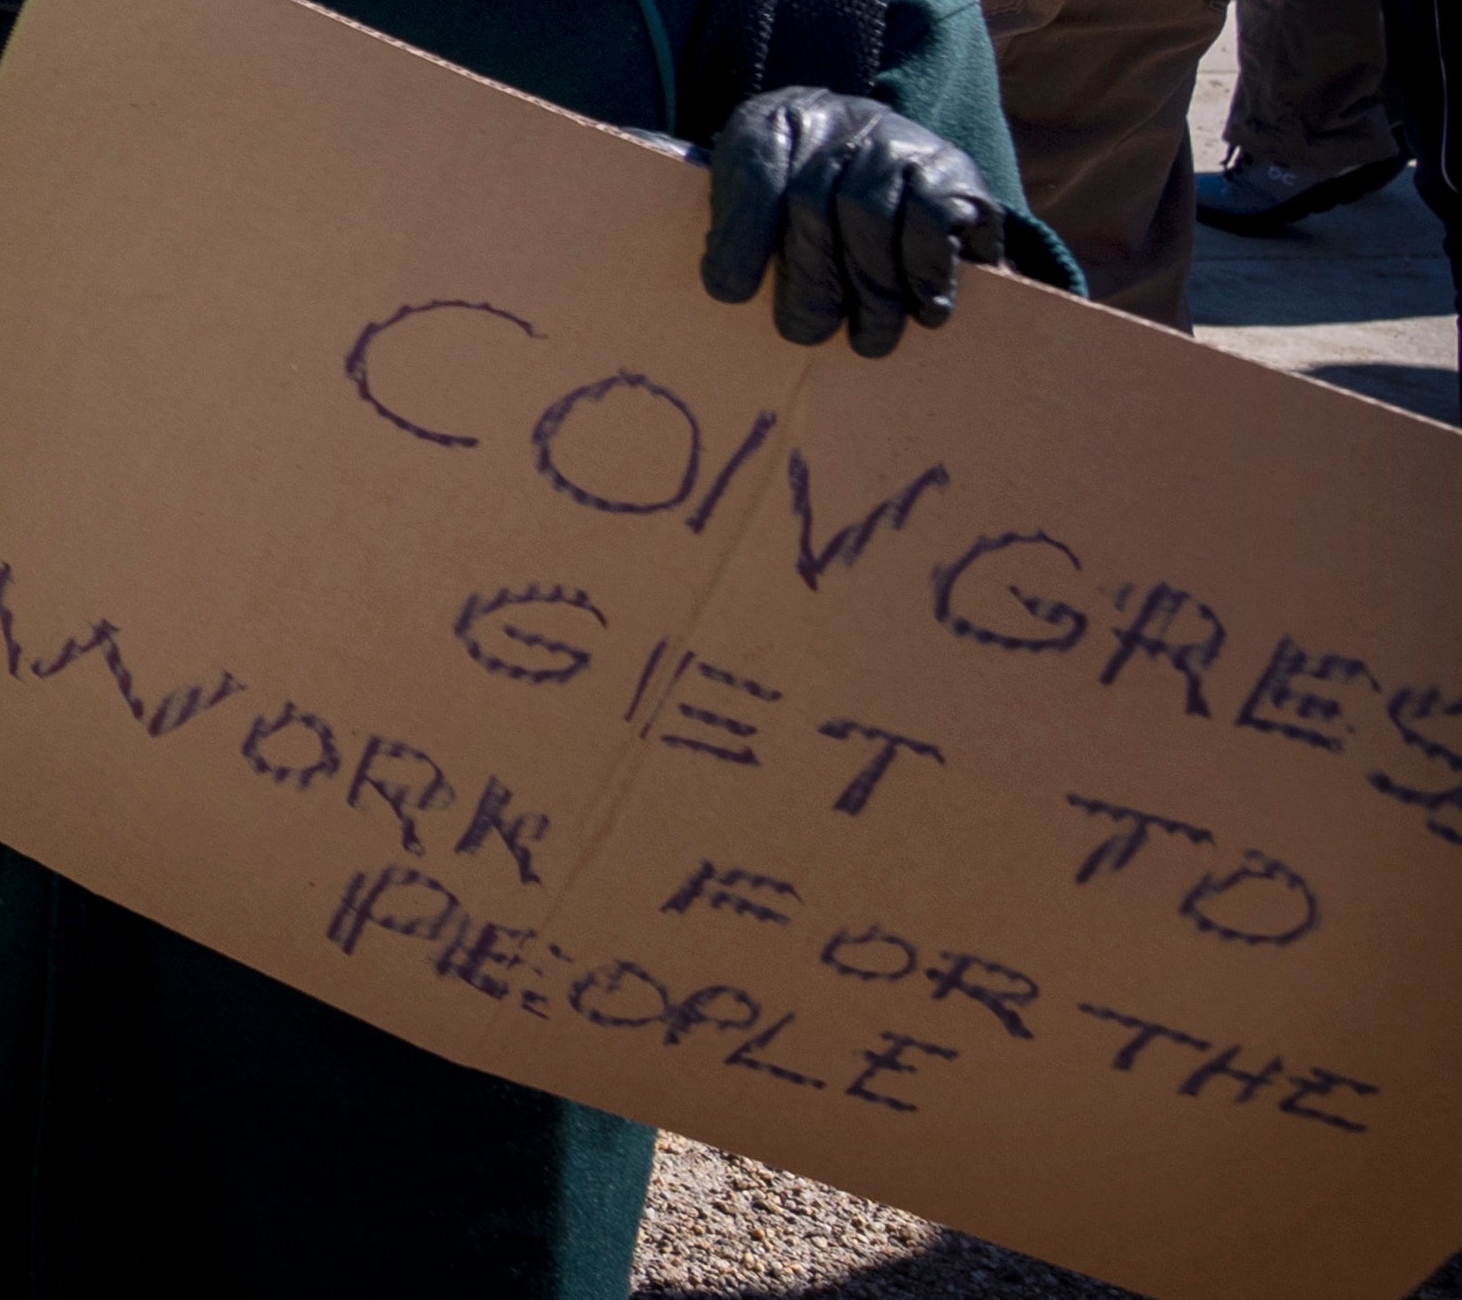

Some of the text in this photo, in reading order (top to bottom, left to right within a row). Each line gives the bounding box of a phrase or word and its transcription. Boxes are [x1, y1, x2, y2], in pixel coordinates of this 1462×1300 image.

[452, 582, 1322, 947] GET TO
[326, 863, 960, 1113] PEOPLE
[659, 859, 1039, 1041] FOR
[1076, 1002, 1382, 1135] THE
